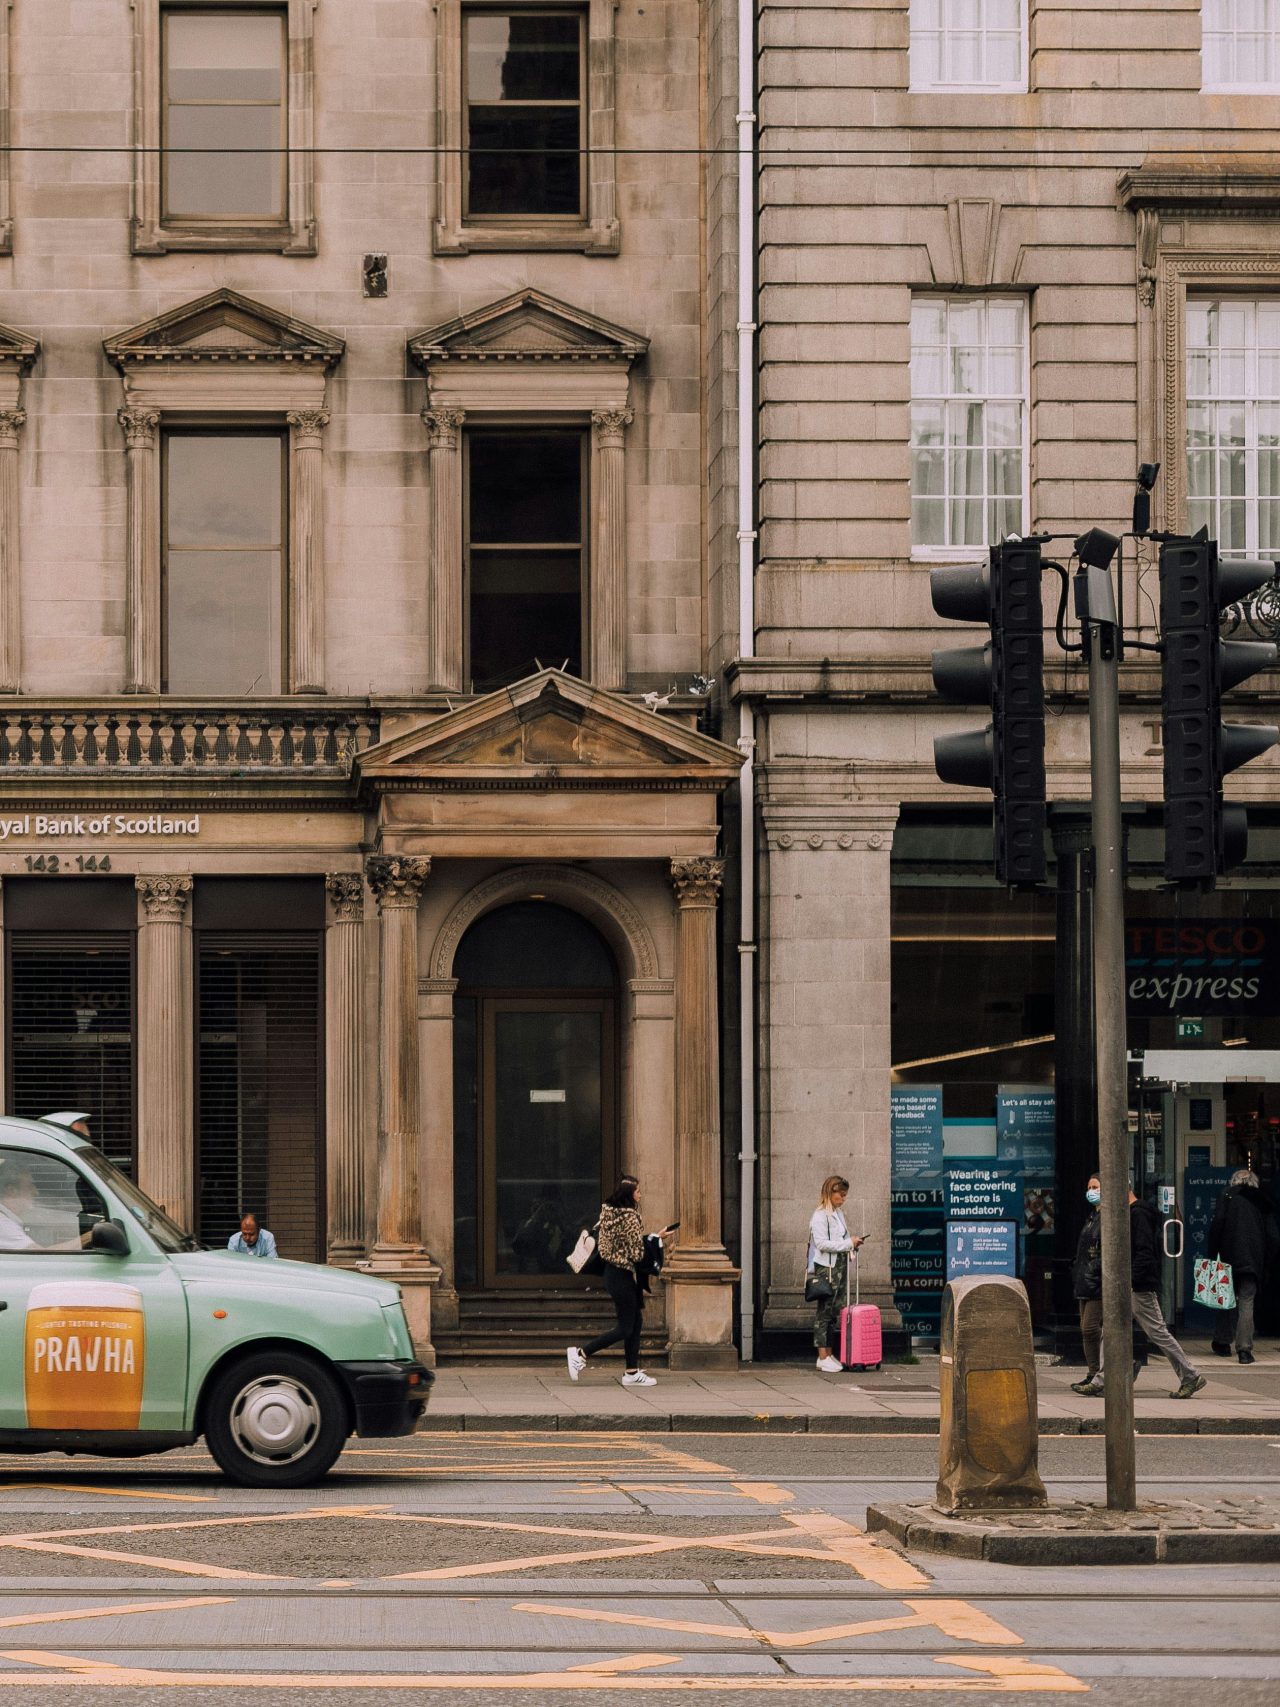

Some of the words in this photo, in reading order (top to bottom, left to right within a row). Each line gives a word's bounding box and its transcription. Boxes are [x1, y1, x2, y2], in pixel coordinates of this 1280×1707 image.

[35, 815, 84, 835] Bank
[89, 814, 110, 834] of
[115, 815, 200, 834] Scotland
[1128, 927, 1265, 954] TESCO
[1129, 973, 1259, 1008] express
[1028, 1099, 1042, 1107] stay
[895, 1111, 925, 1119] feedback
[949, 1169, 990, 1181] Wearing
[950, 1182, 971, 1191] face
[974, 1181, 1016, 1192] covering
[1214, 1178, 1227, 1186] stay
[912, 1191, 927, 1203] to
[993, 1193, 1001, 1203] is
[950, 1206, 1004, 1217] mandatory
[950, 1225, 966, 1233] Let's
[967, 1225, 976, 1233] all
[977, 1226, 992, 1235] stay
[992, 1225, 1008, 1233] safe
[913, 1257, 933, 1270] Top
[917, 1321, 932, 1331] Go
[34, 1336, 135, 1374] PRAVHA
